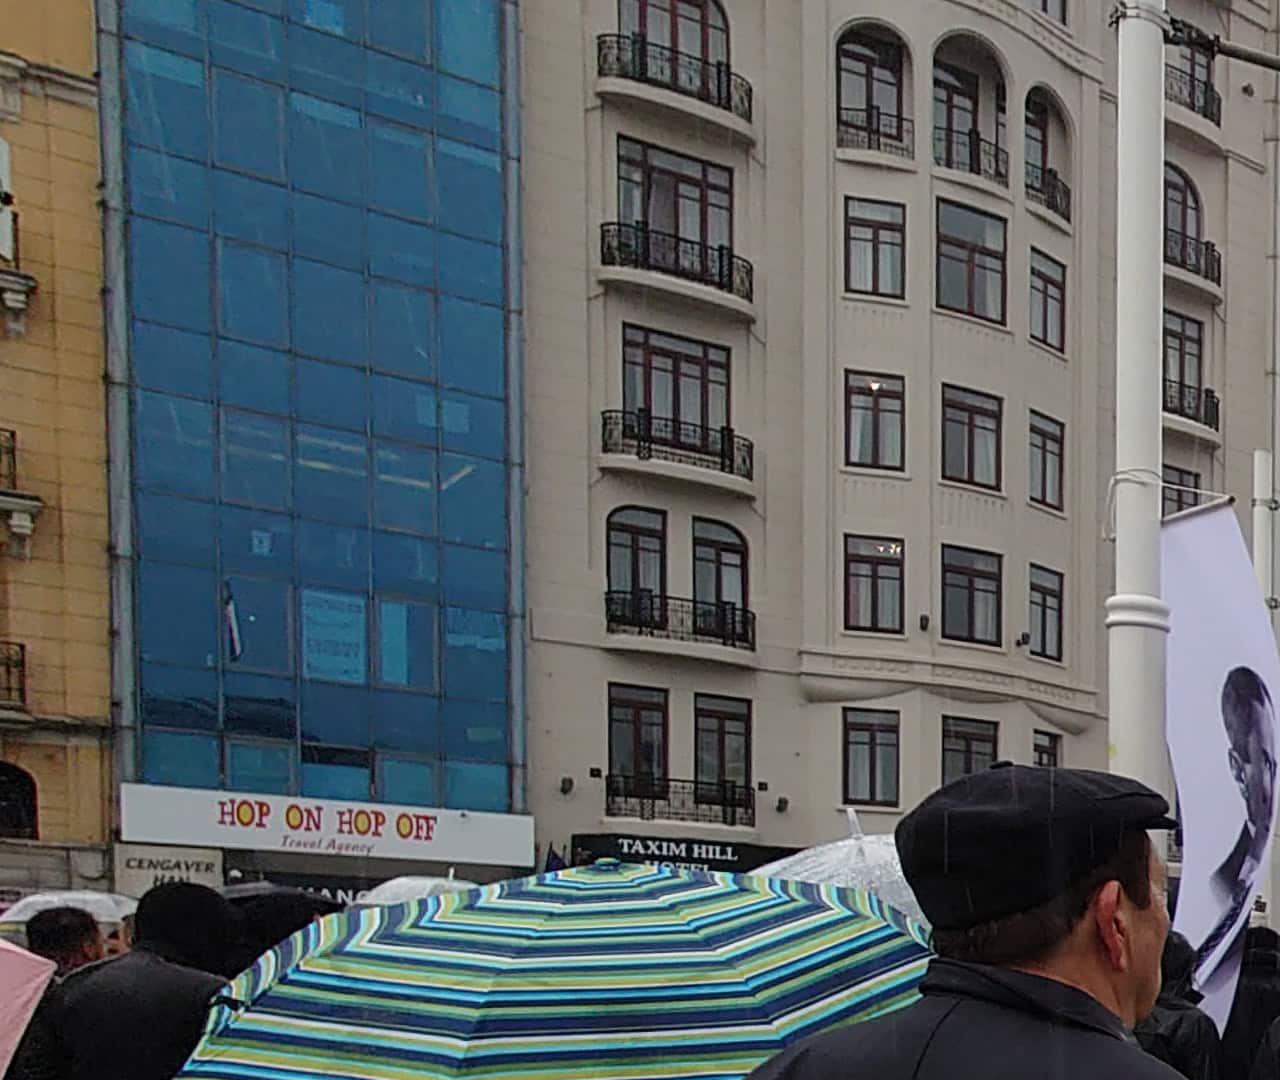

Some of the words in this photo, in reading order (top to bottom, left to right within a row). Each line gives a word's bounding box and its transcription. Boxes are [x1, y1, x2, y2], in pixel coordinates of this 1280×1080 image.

[218, 798, 271, 828] HOP
[285, 803, 324, 832] ON
[337, 809, 386, 837] HOP
[396, 813, 438, 841] OFF
[281, 834, 322, 849] Travel
[324, 838, 375, 857] Agency
[618, 838, 687, 858] TAXIM
[693, 844, 739, 861] HILL
